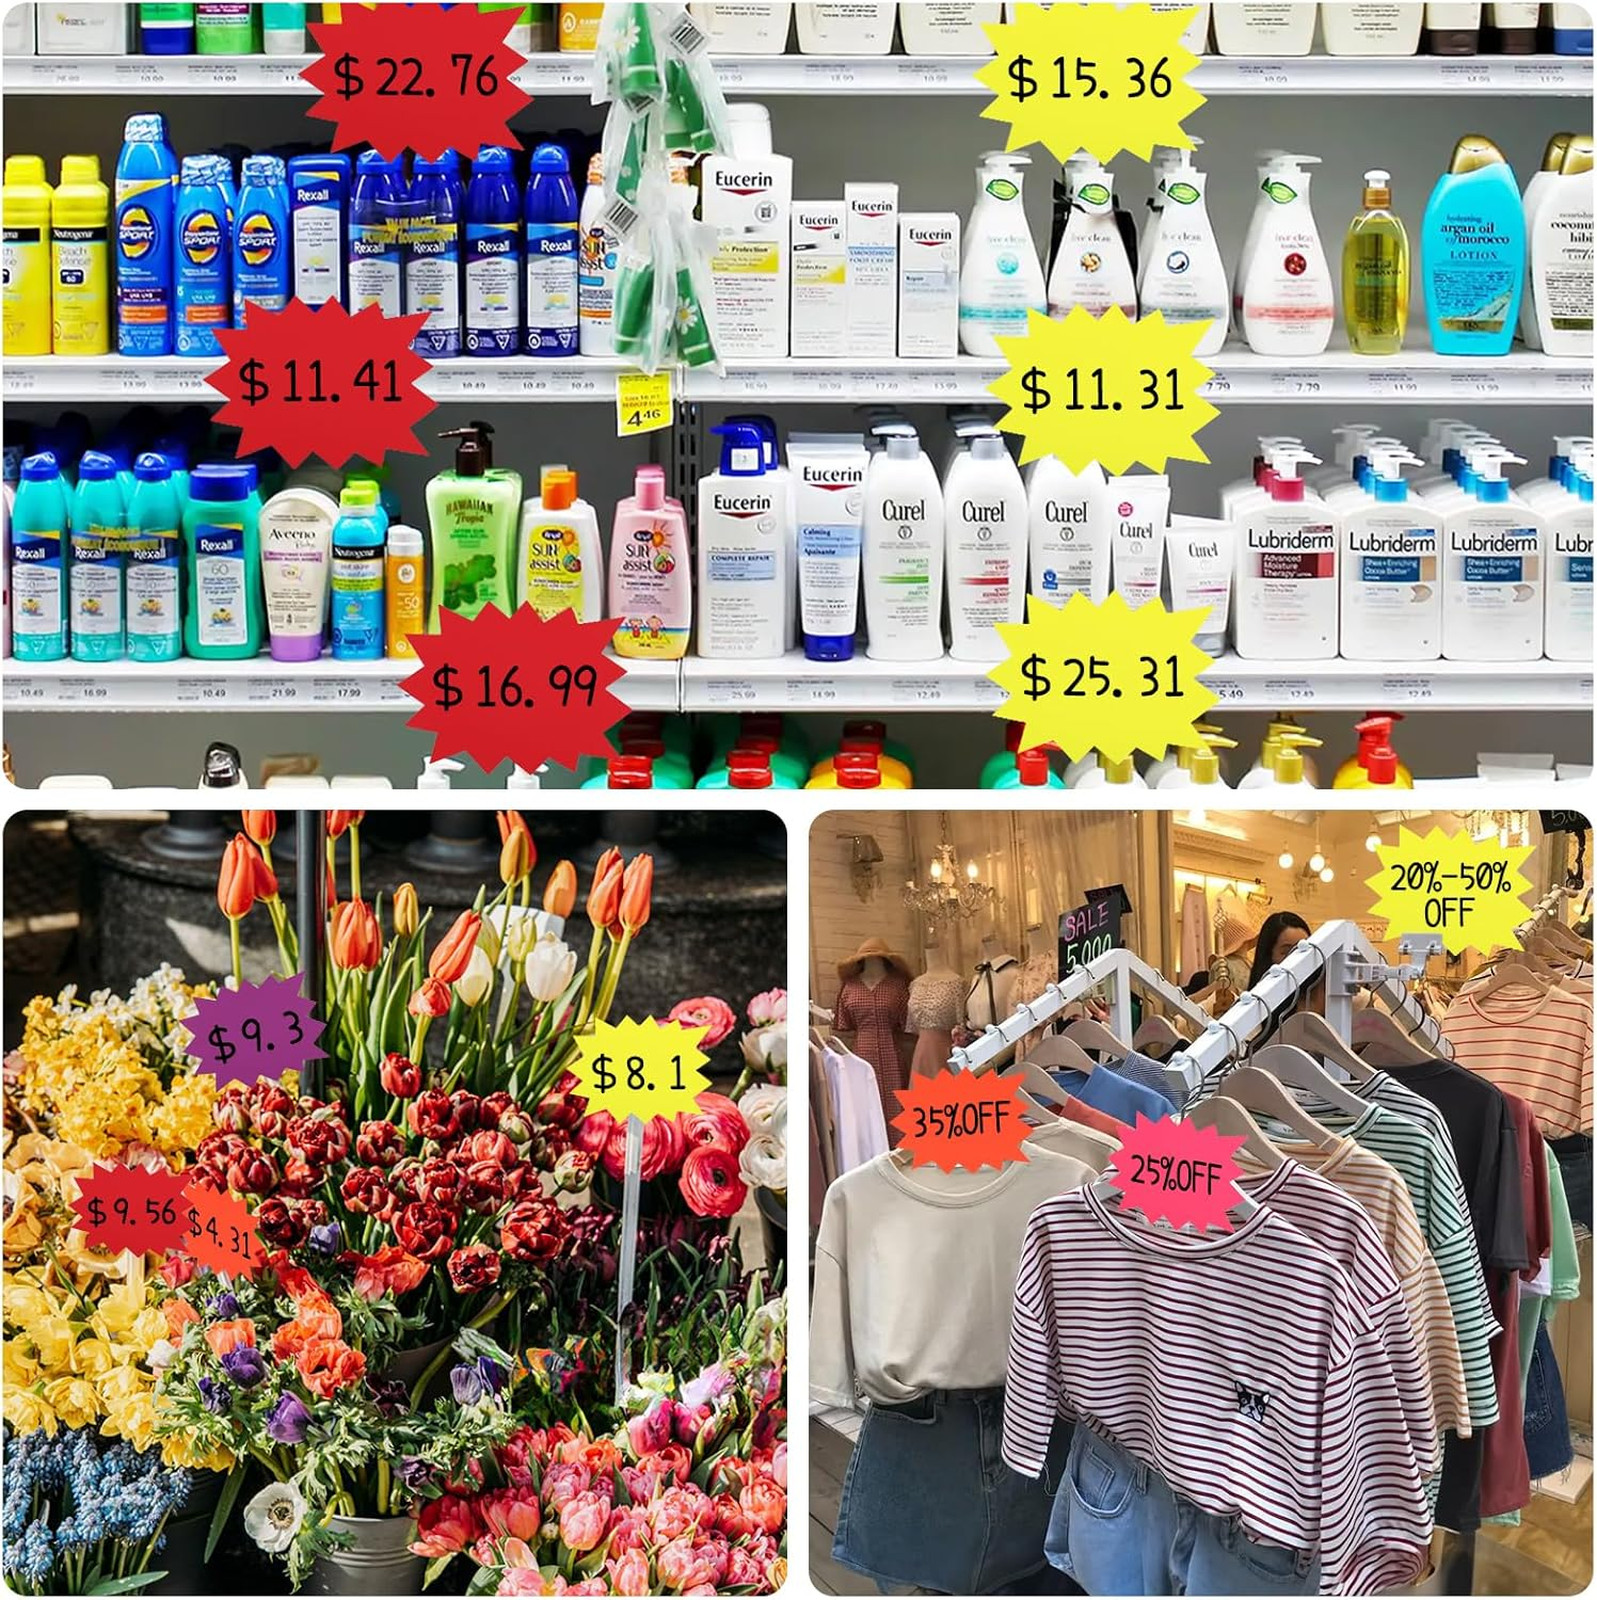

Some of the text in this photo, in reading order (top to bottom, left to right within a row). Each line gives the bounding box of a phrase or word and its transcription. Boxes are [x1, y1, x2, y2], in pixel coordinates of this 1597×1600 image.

[715, 170, 773, 187] Eucerin
[297, 189, 329, 201] Rexall
[852, 200, 893, 212] Eucerin
[799, 214, 839, 226] Eucerin
[908, 228, 952, 241] Eucerin
[1441, 222, 1494, 236] argan oil
[541, 240, 572, 253] Rexall
[1458, 235, 1510, 245] morocco
[354, 241, 385, 254] Rexall
[414, 241, 446, 254] Rexall
[478, 241, 510, 253] Rexall
[1450, 250, 1498, 260] LOTION
[803, 465, 863, 483] Eucerin
[713, 494, 772, 511] Eucerin
[269, 528, 316, 541] Aveeno
[1248, 528, 1334, 549] Lubriderm
[200, 539, 233, 552] Rexall
[1349, 532, 1436, 552] Lubriderm
[1451, 532, 1538, 552] Lubriderm
[15, 545, 46, 559] Rexall
[75, 547, 106, 561] Rexall
[133, 548, 166, 560] Rexall
[532, 543, 559, 556] SUN
[626, 543, 650, 558] SUN
[529, 558, 561, 571] assist
[1263, 554, 1302, 563] Advanced
[622, 559, 652, 572] assist
[272, 688, 297, 698] 21.99
[337, 688, 361, 698] 17.99
[1391, 861, 1512, 894] 20%-50%
[1425, 898, 1476, 928] OFF
[1065, 901, 1109, 942] SALE
